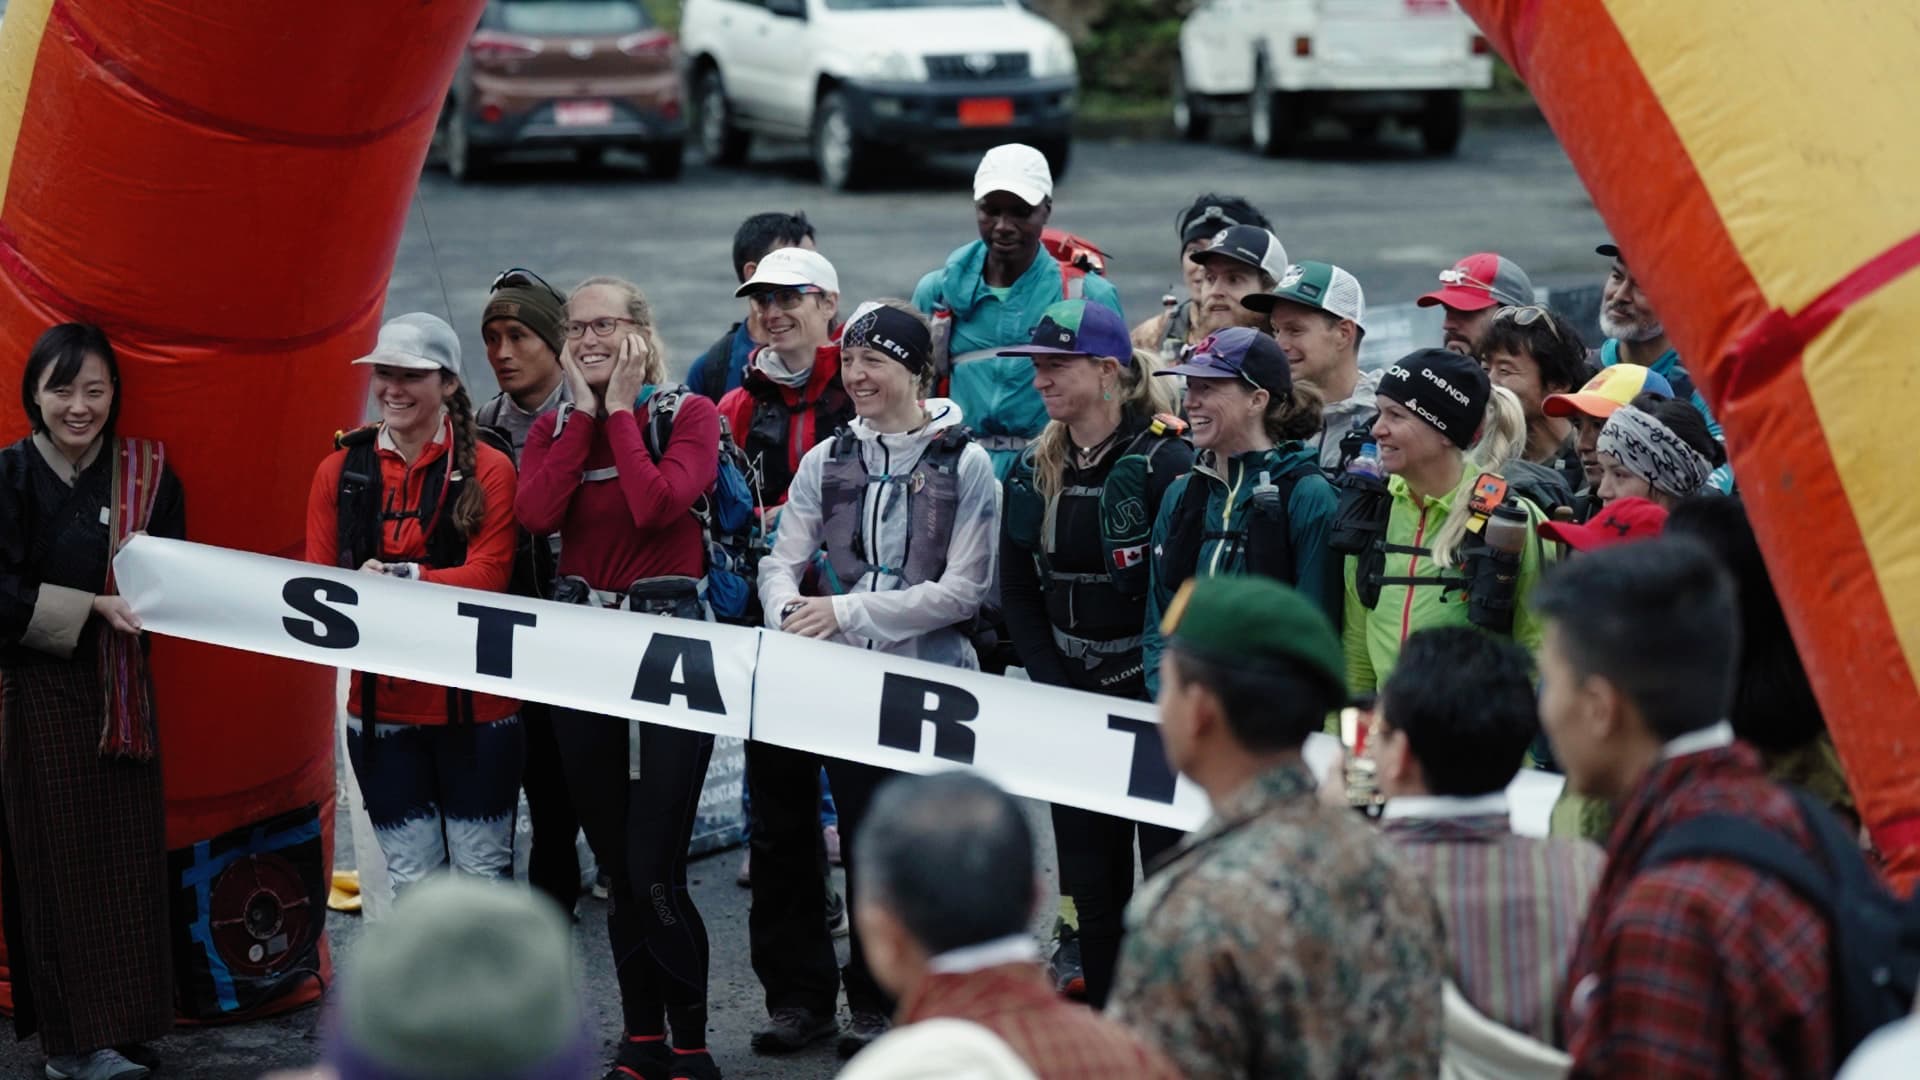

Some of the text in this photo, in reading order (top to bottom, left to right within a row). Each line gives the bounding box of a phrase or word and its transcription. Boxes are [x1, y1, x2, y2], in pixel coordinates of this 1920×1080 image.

[871, 334, 910, 359] LEKI
[1388, 365, 1411, 382] OR
[1444, 384, 1471, 407] NOR
[1100, 662, 1145, 686] SALOM
[282, 577, 1178, 805] START
